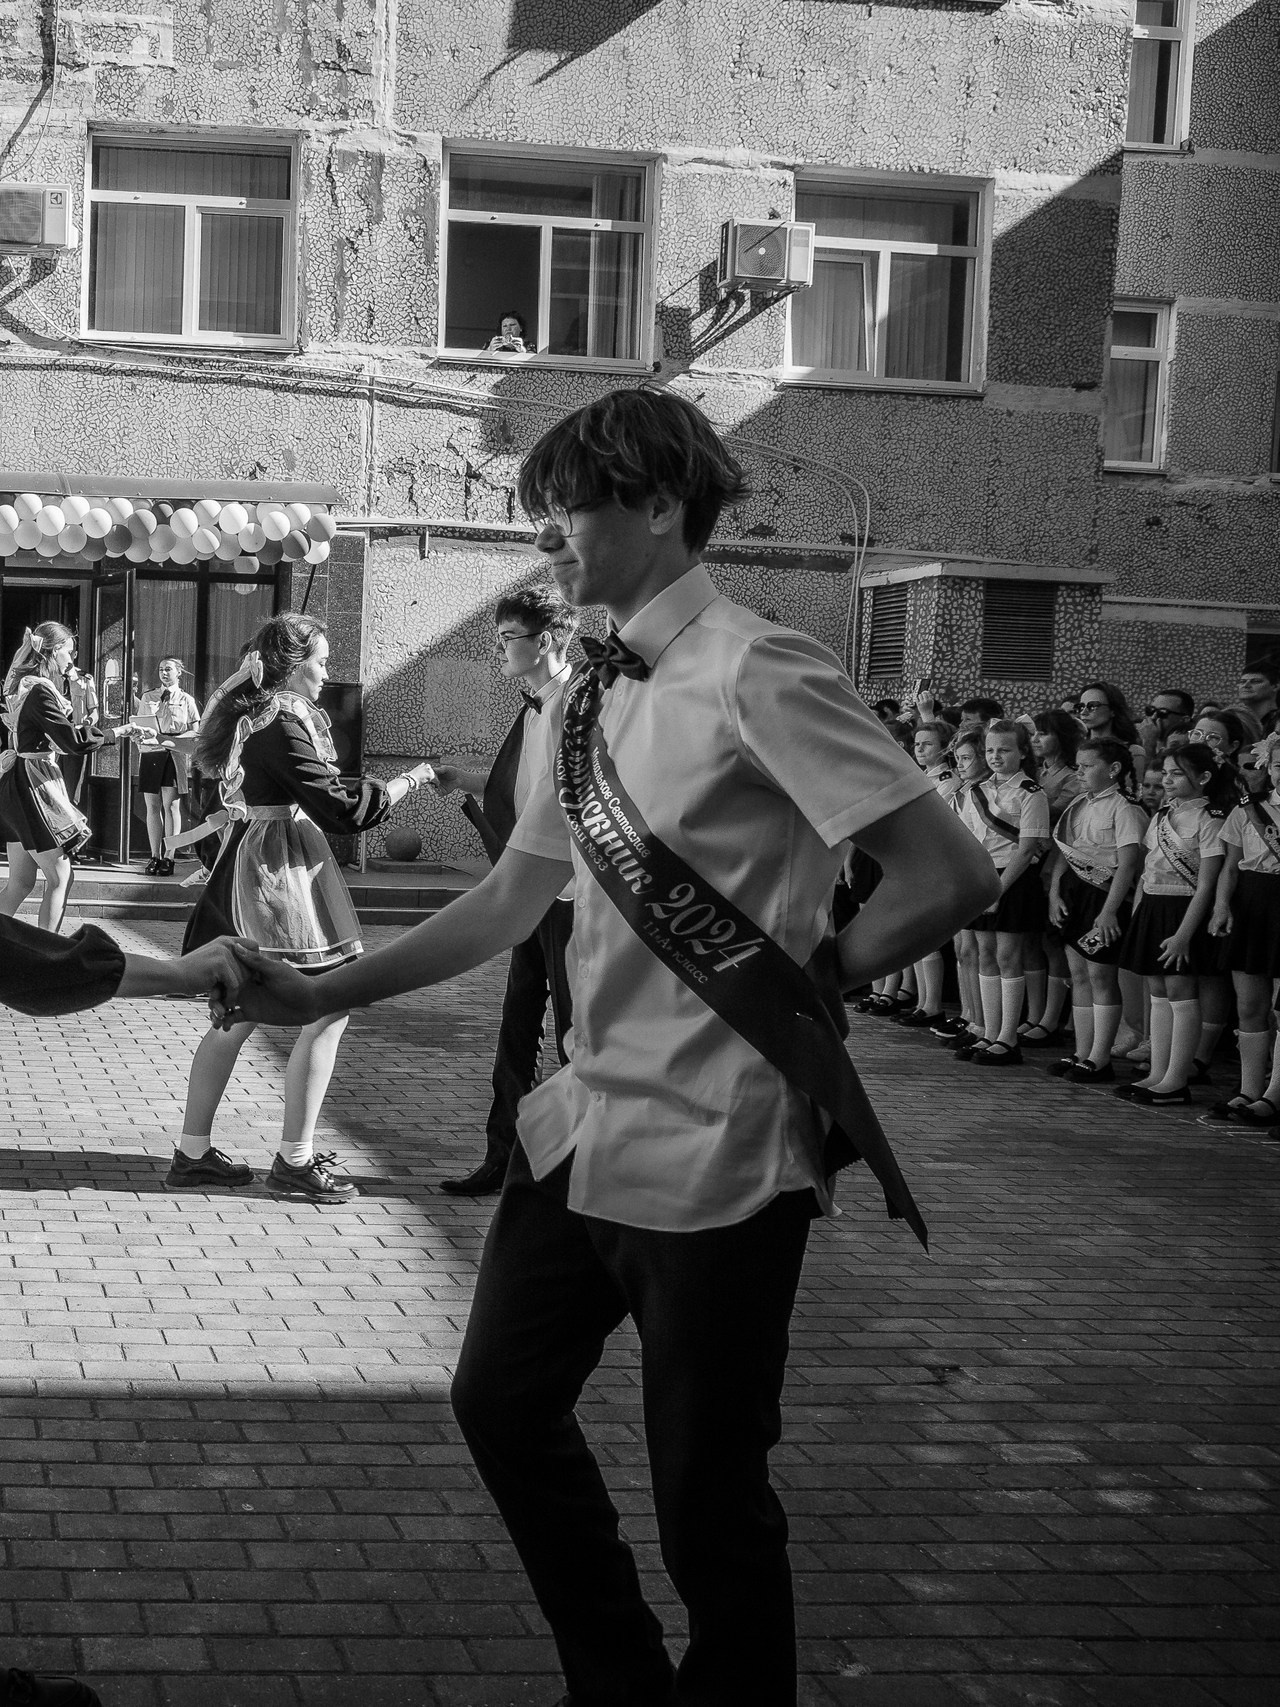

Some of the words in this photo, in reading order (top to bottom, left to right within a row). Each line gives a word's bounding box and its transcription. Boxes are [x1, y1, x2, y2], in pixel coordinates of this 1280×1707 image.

[566, 814, 588, 843] СОШ
[584, 842, 609, 872] №33
[608, 797, 651, 858] Святослав
[644, 882, 766, 973] 2024
[671, 950, 709, 984] класс
